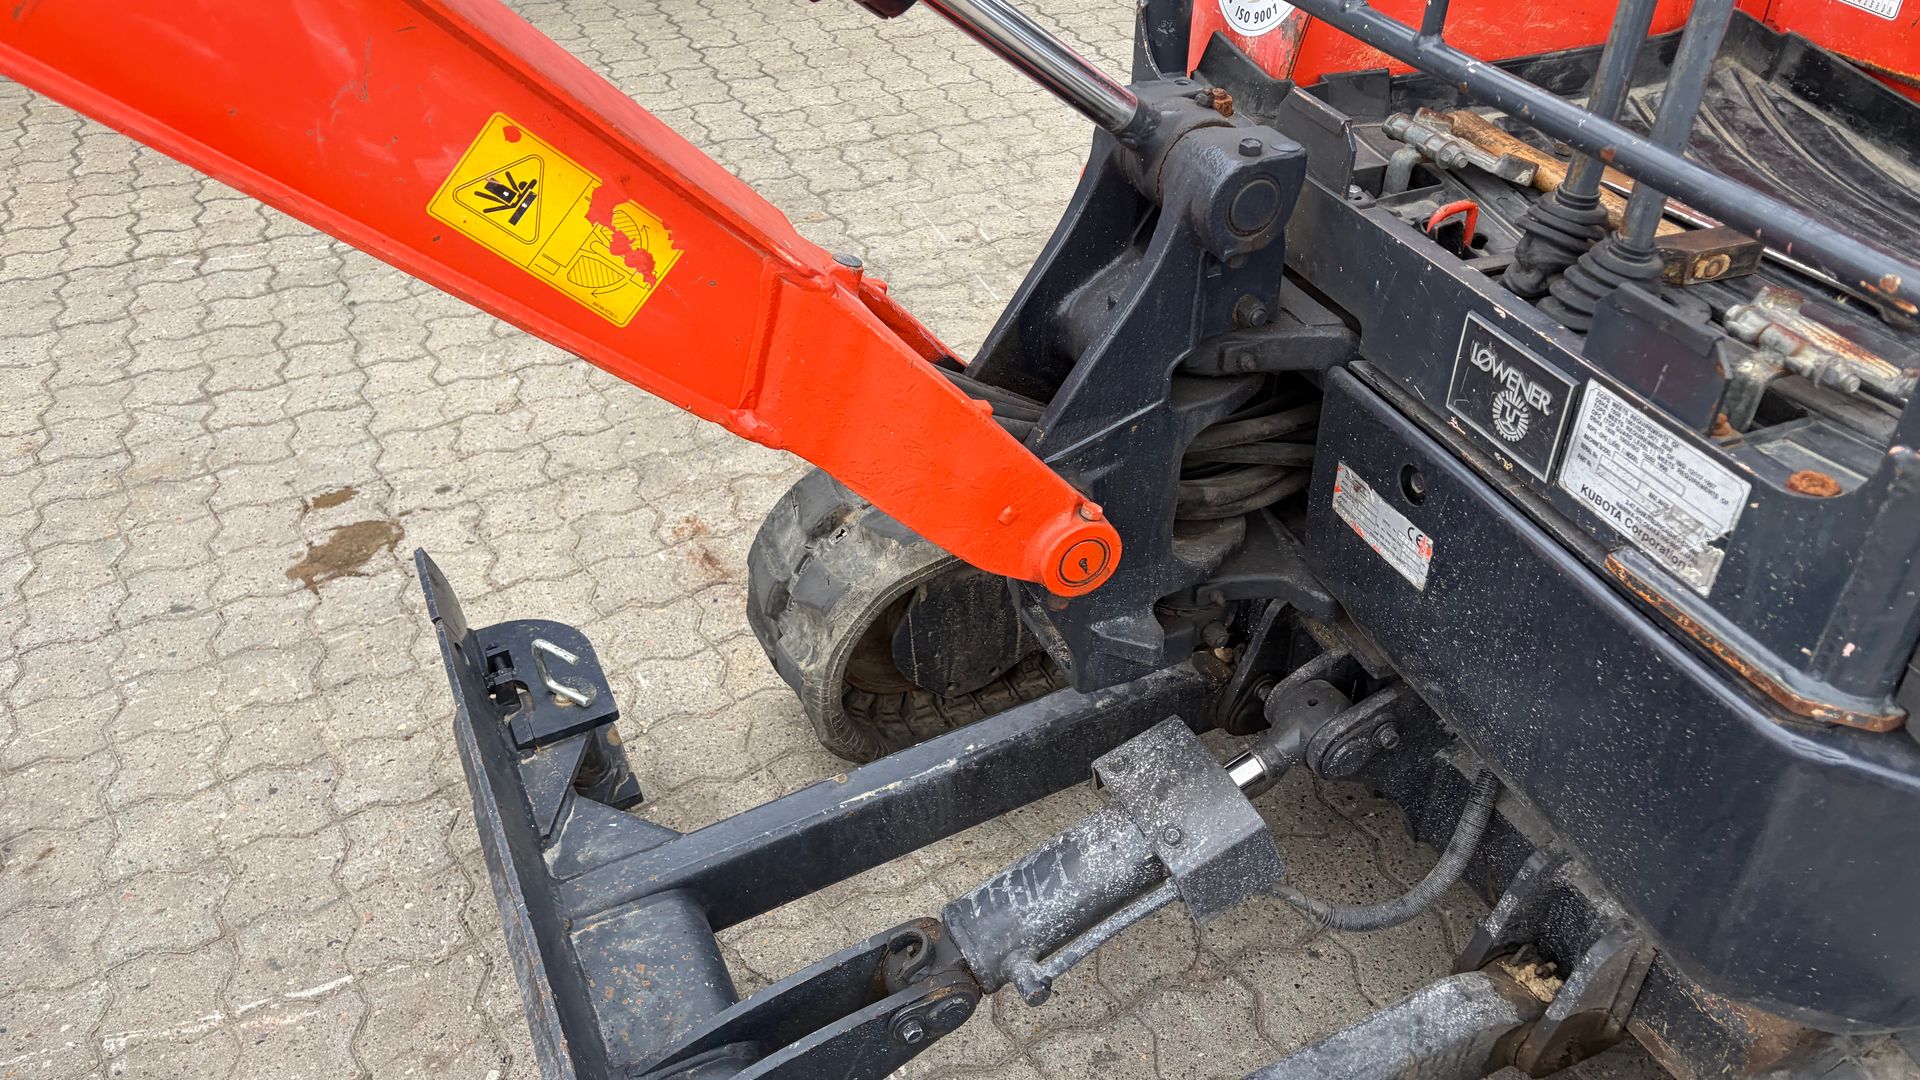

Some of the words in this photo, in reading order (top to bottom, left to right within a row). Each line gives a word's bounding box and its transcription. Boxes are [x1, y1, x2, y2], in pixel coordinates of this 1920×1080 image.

[1235, 5, 1251, 24] ISO
[1253, 3, 1278, 24] 9001
[1470, 339, 1554, 417] LØWENER
[1580, 484, 1622, 522] KUBOTA
[1624, 516, 1686, 569] Corporation
